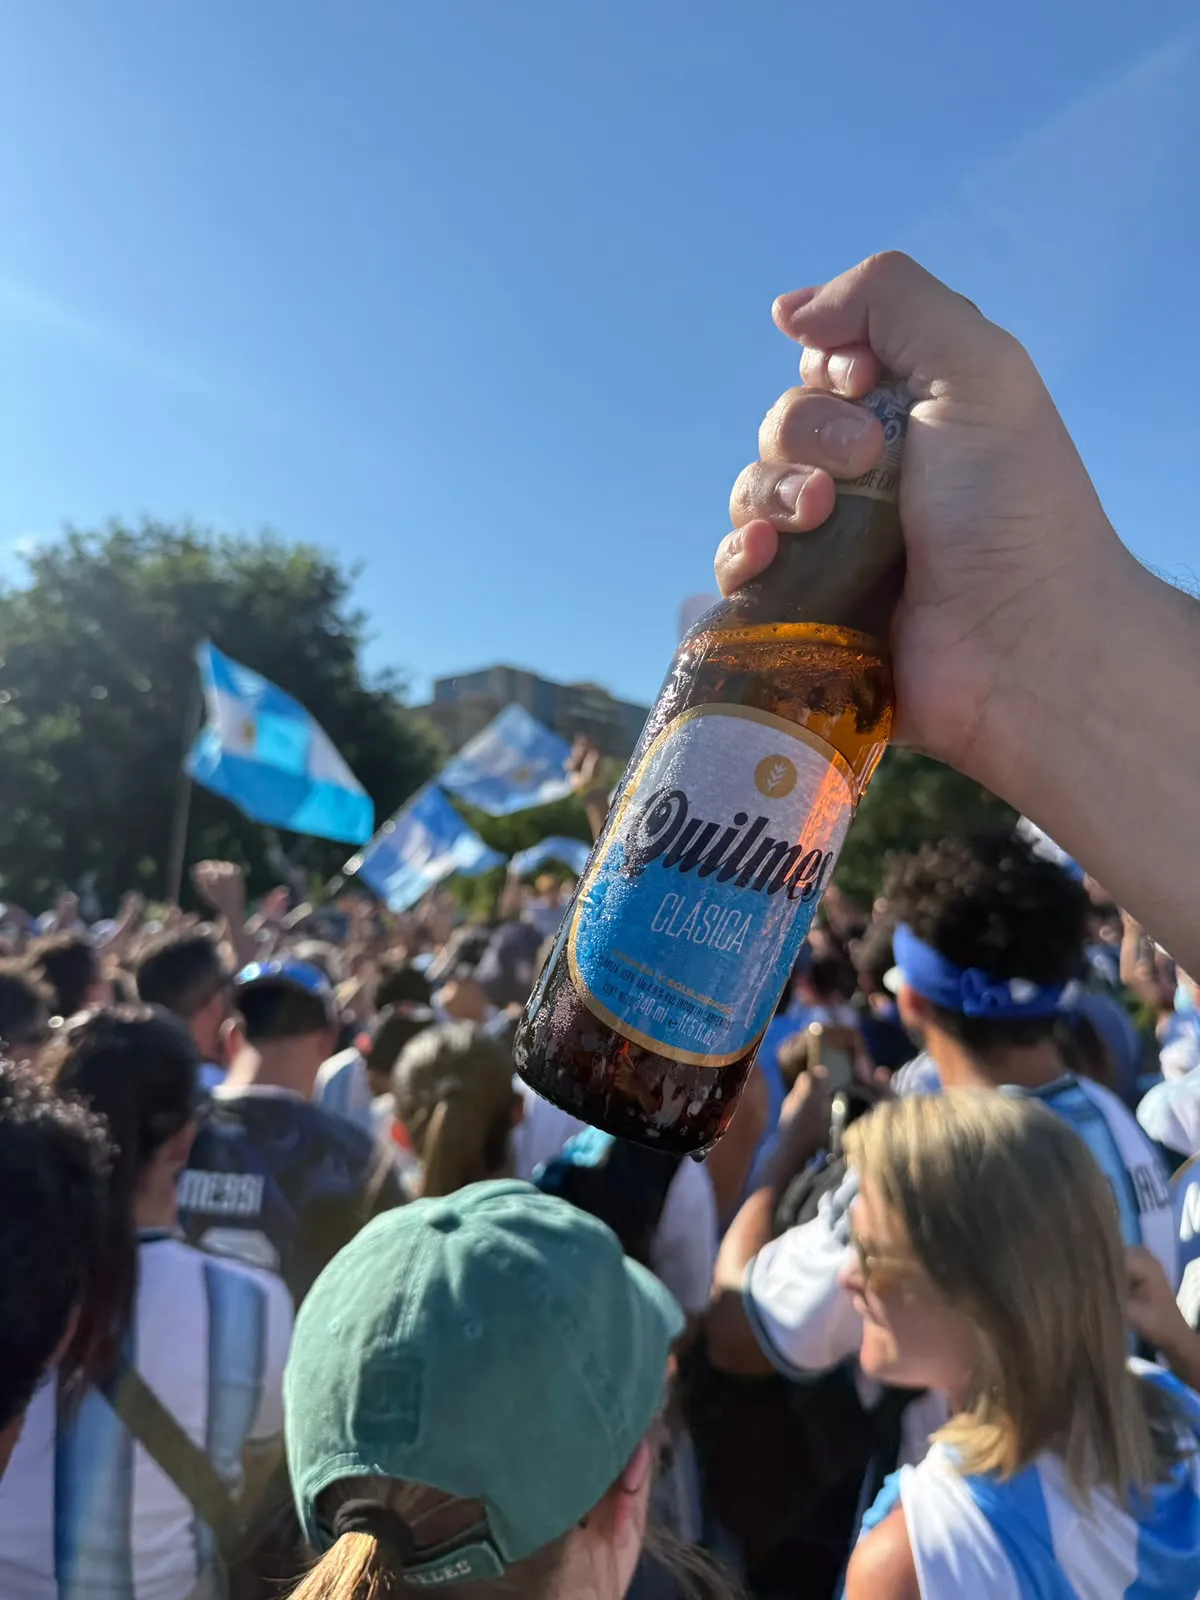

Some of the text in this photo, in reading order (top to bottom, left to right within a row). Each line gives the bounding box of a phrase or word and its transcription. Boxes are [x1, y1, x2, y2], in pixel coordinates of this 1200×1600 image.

[618, 788, 834, 902] Quilmes
[651, 892, 753, 953] CLÁSICA
[633, 991, 656, 1017] 340
[652, 1005, 670, 1024] ml
[176, 1169, 265, 1216] MESSI
